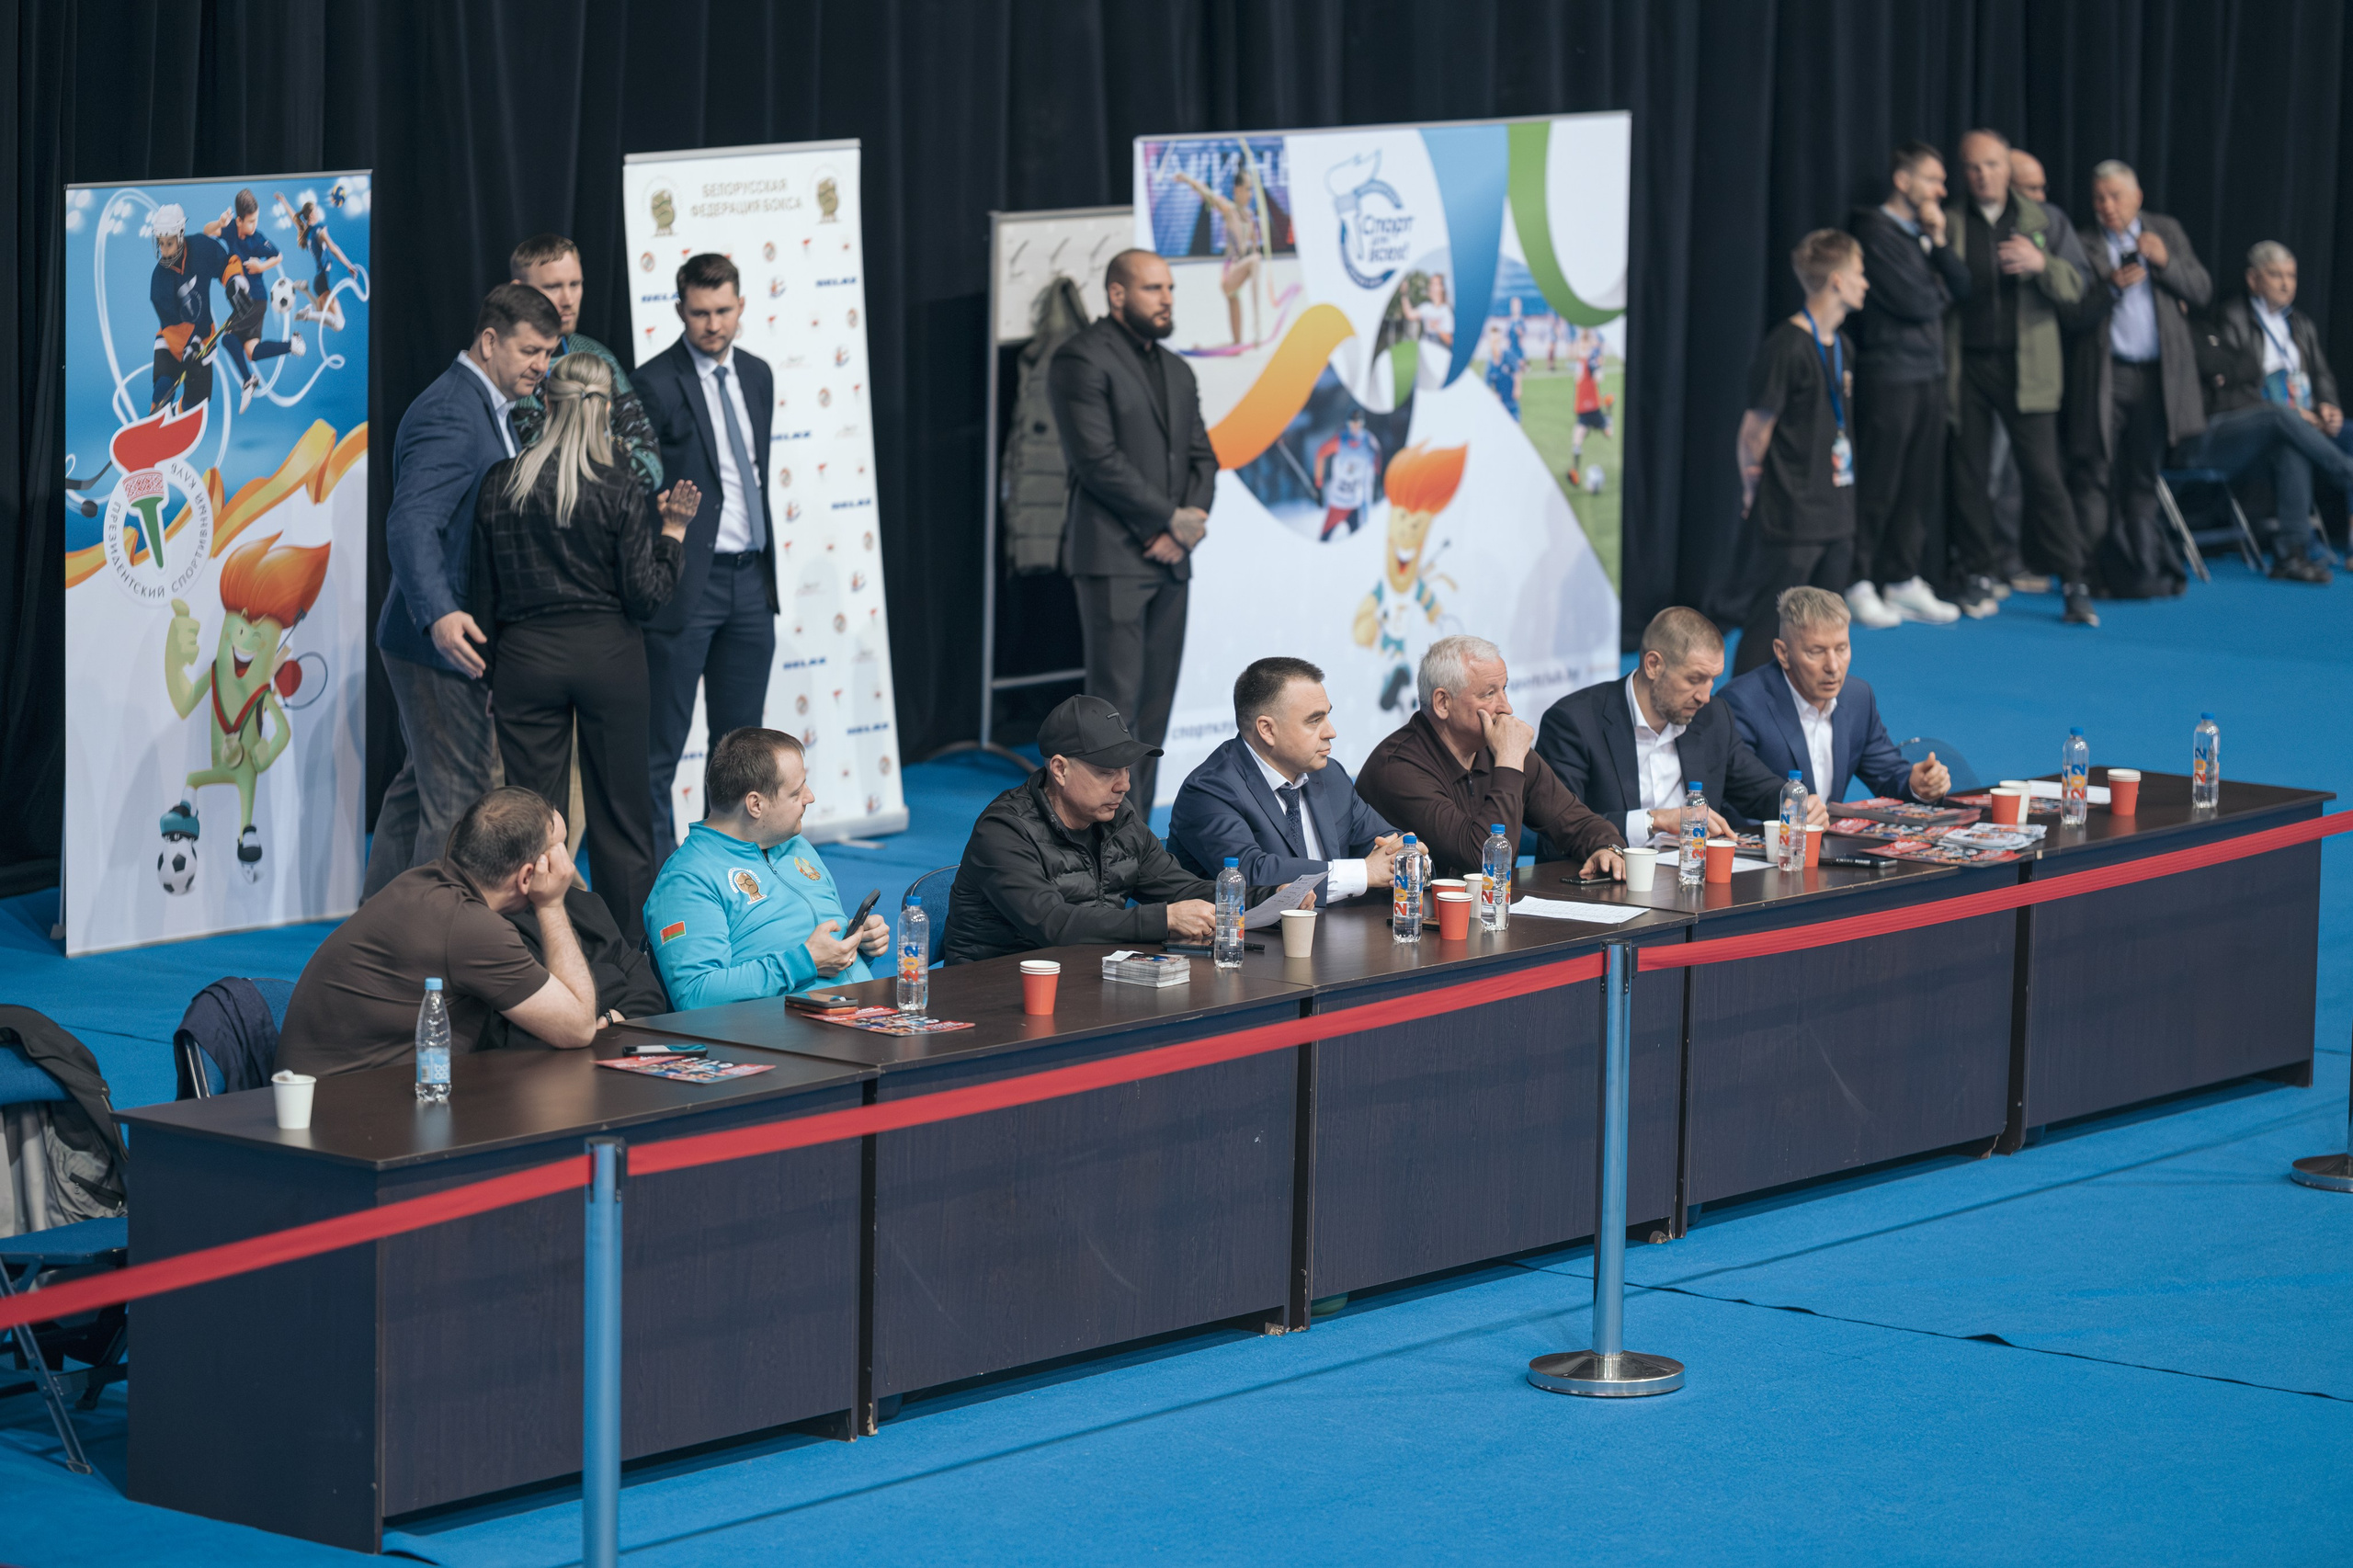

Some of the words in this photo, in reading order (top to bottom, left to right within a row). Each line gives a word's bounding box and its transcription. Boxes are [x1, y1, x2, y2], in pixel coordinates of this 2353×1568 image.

[171, 462, 197, 490] КЛУБ
[108, 501, 165, 598] ПРЕЗИДЕНТСКИЙ
[171, 492, 208, 593] СПОРТИВНЫЙ
[2070, 763, 2086, 801] 202
[1691, 827, 1706, 859] 202
[1393, 874, 1408, 916] 202
[1495, 864, 1505, 905] CLASSIC
[904, 945, 919, 983] 202
